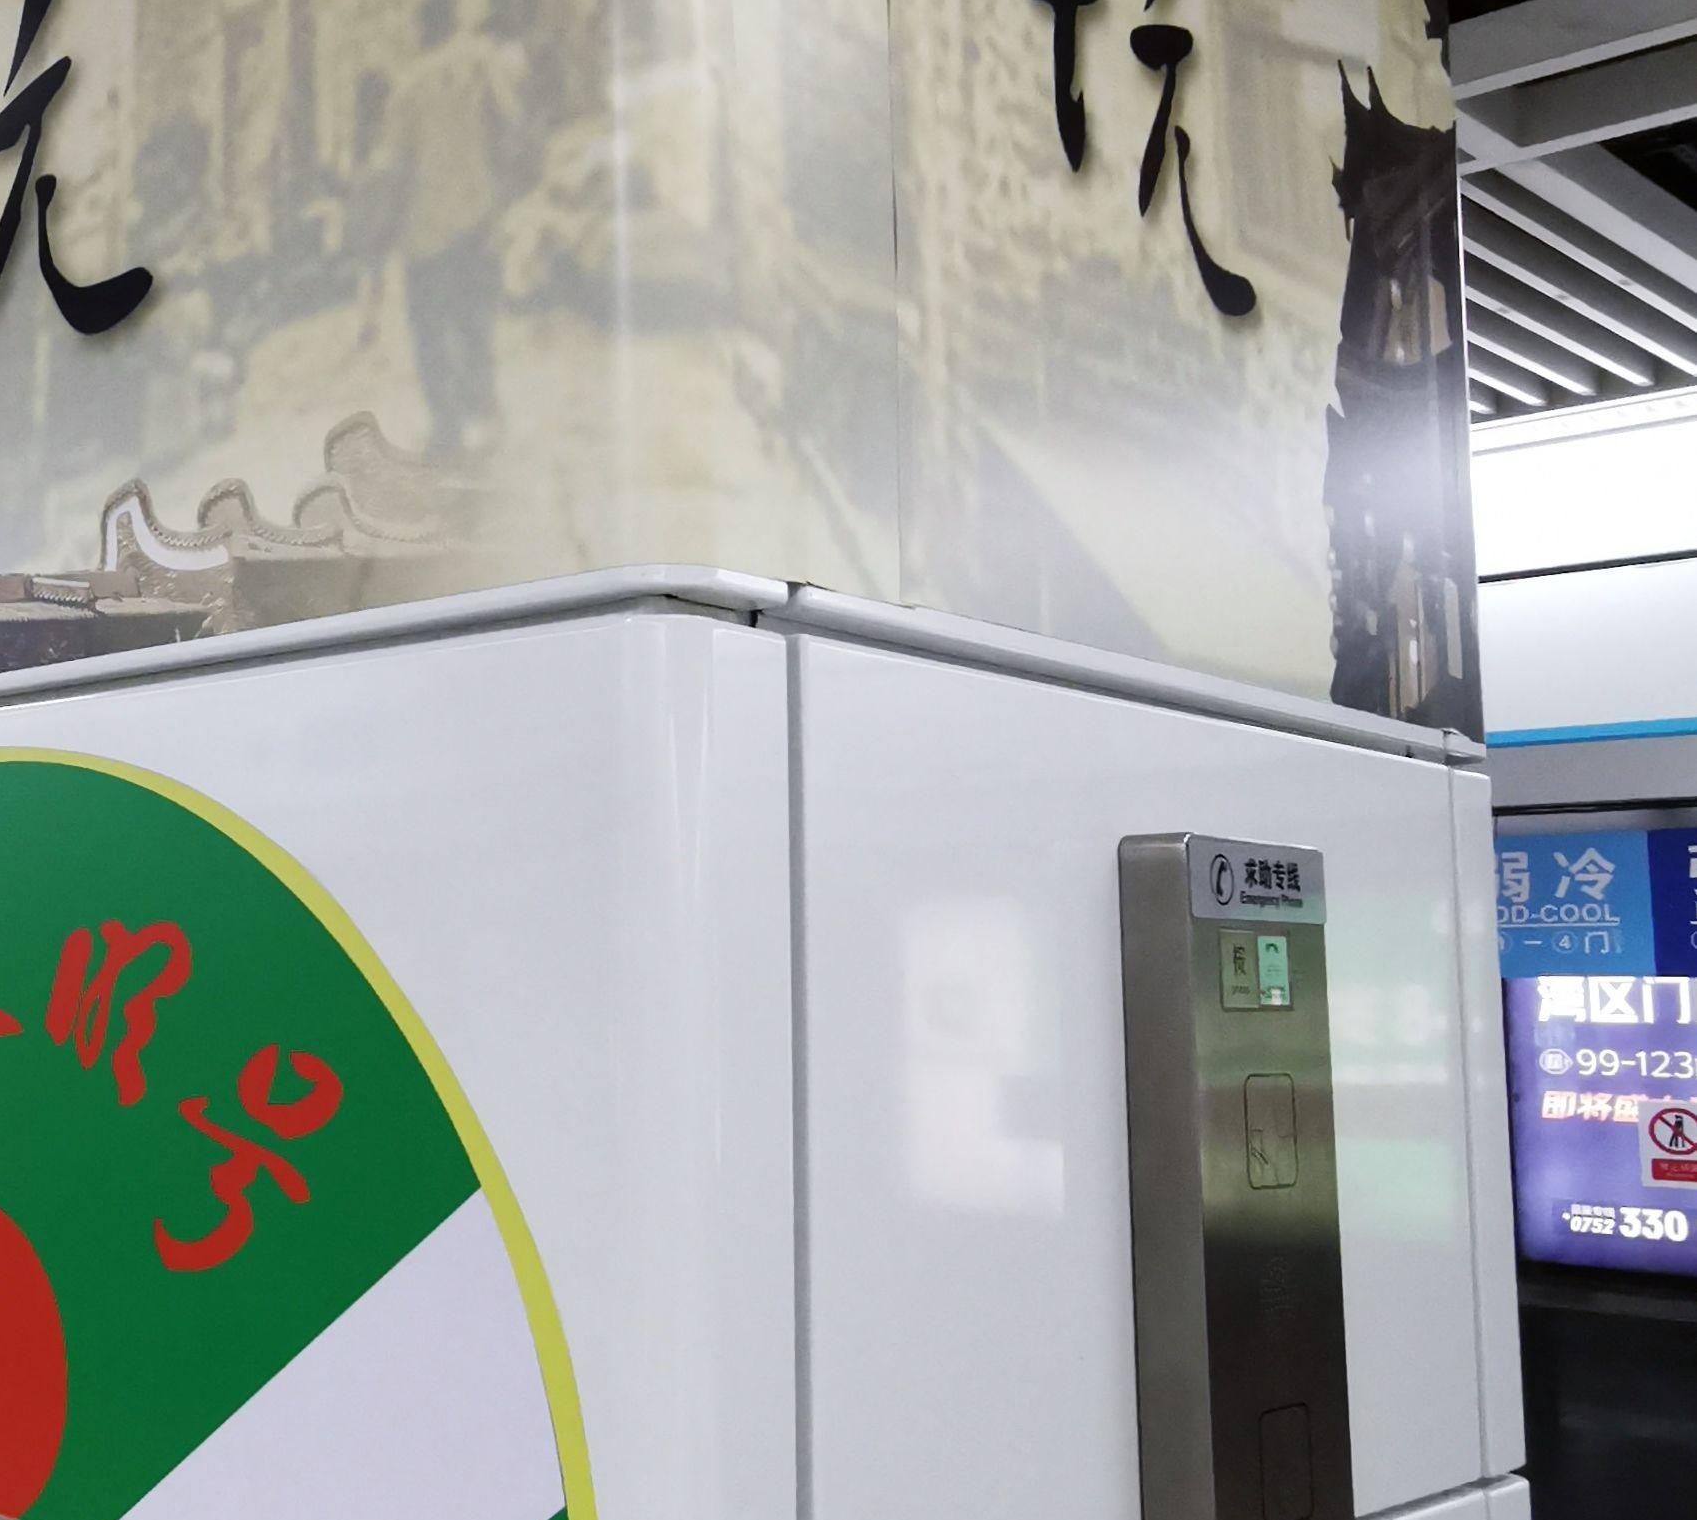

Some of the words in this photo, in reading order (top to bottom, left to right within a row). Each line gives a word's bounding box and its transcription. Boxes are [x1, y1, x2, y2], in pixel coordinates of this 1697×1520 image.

[1497, 903, 1621, 924] OD-COOL
[1537, 975, 1697, 1025] 湾区门
[1575, 1048, 1697, 1079] 99-123
[1569, 1217, 1616, 1235] 0752
[1619, 1206, 1689, 1242] 330
